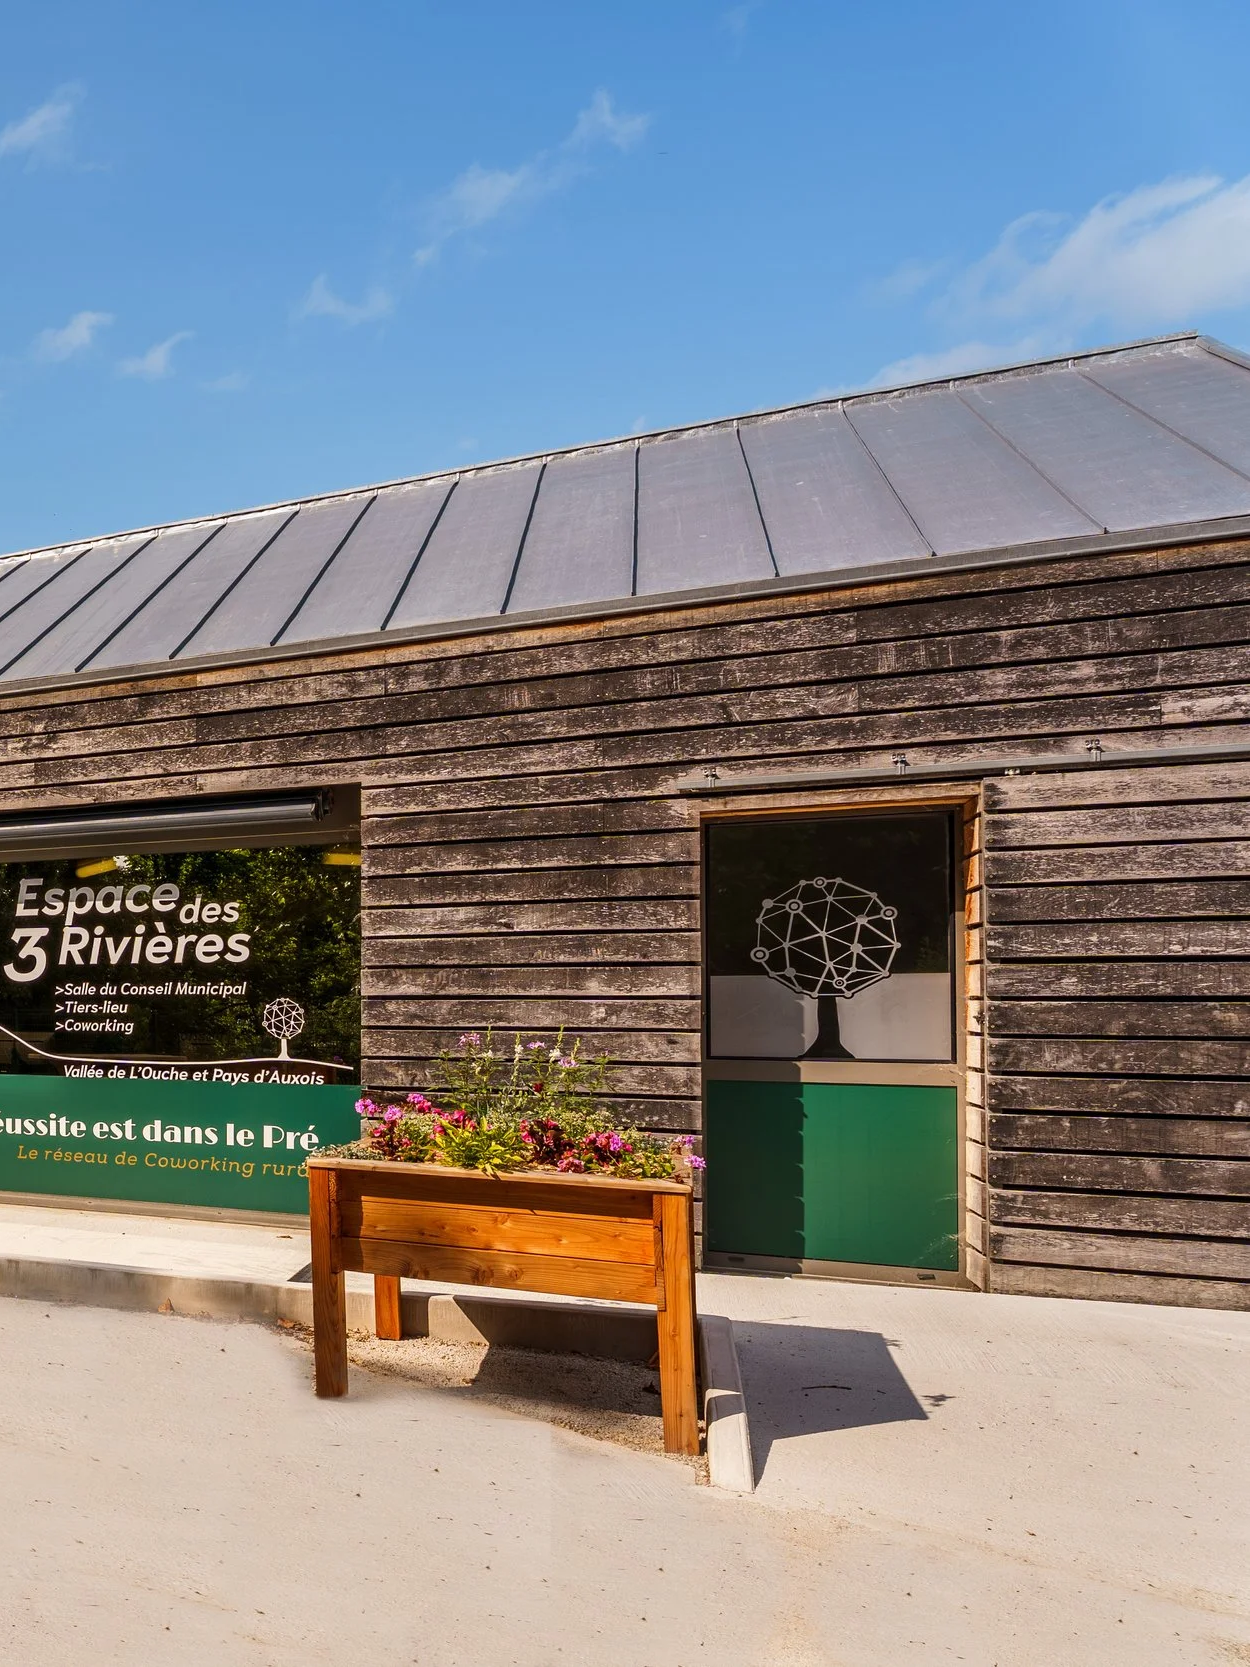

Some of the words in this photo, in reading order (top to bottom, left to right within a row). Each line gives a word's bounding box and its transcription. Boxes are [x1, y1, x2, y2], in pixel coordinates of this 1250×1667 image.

[15, 878, 180, 926] Espace
[179, 894, 240, 924] des
[3, 927, 50, 982] 3
[58, 922, 252, 965] Rivières
[100, 983, 117, 996] du
[120, 982, 172, 996] Conseil
[175, 981, 247, 998] Municipal
[63, 1064, 104, 1079] Vallée
[107, 1066, 126, 1079] de
[129, 1067, 189, 1081] L’Ouche
[192, 1069, 208, 1081] et
[212, 1069, 250, 1086] Pays
[254, 1070, 325, 1085] d’Auxois
[92, 1118, 138, 1140] est
[142, 1119, 219, 1145] dans
[226, 1123, 255, 1147] le
[263, 1125, 320, 1151] Pré
[17, 1145, 38, 1160] Le
[44, 1147, 108, 1164] réseau
[114, 1151, 138, 1166] de
[144, 1152, 255, 1178] Coworking
[262, 1162, 310, 1178] rura
